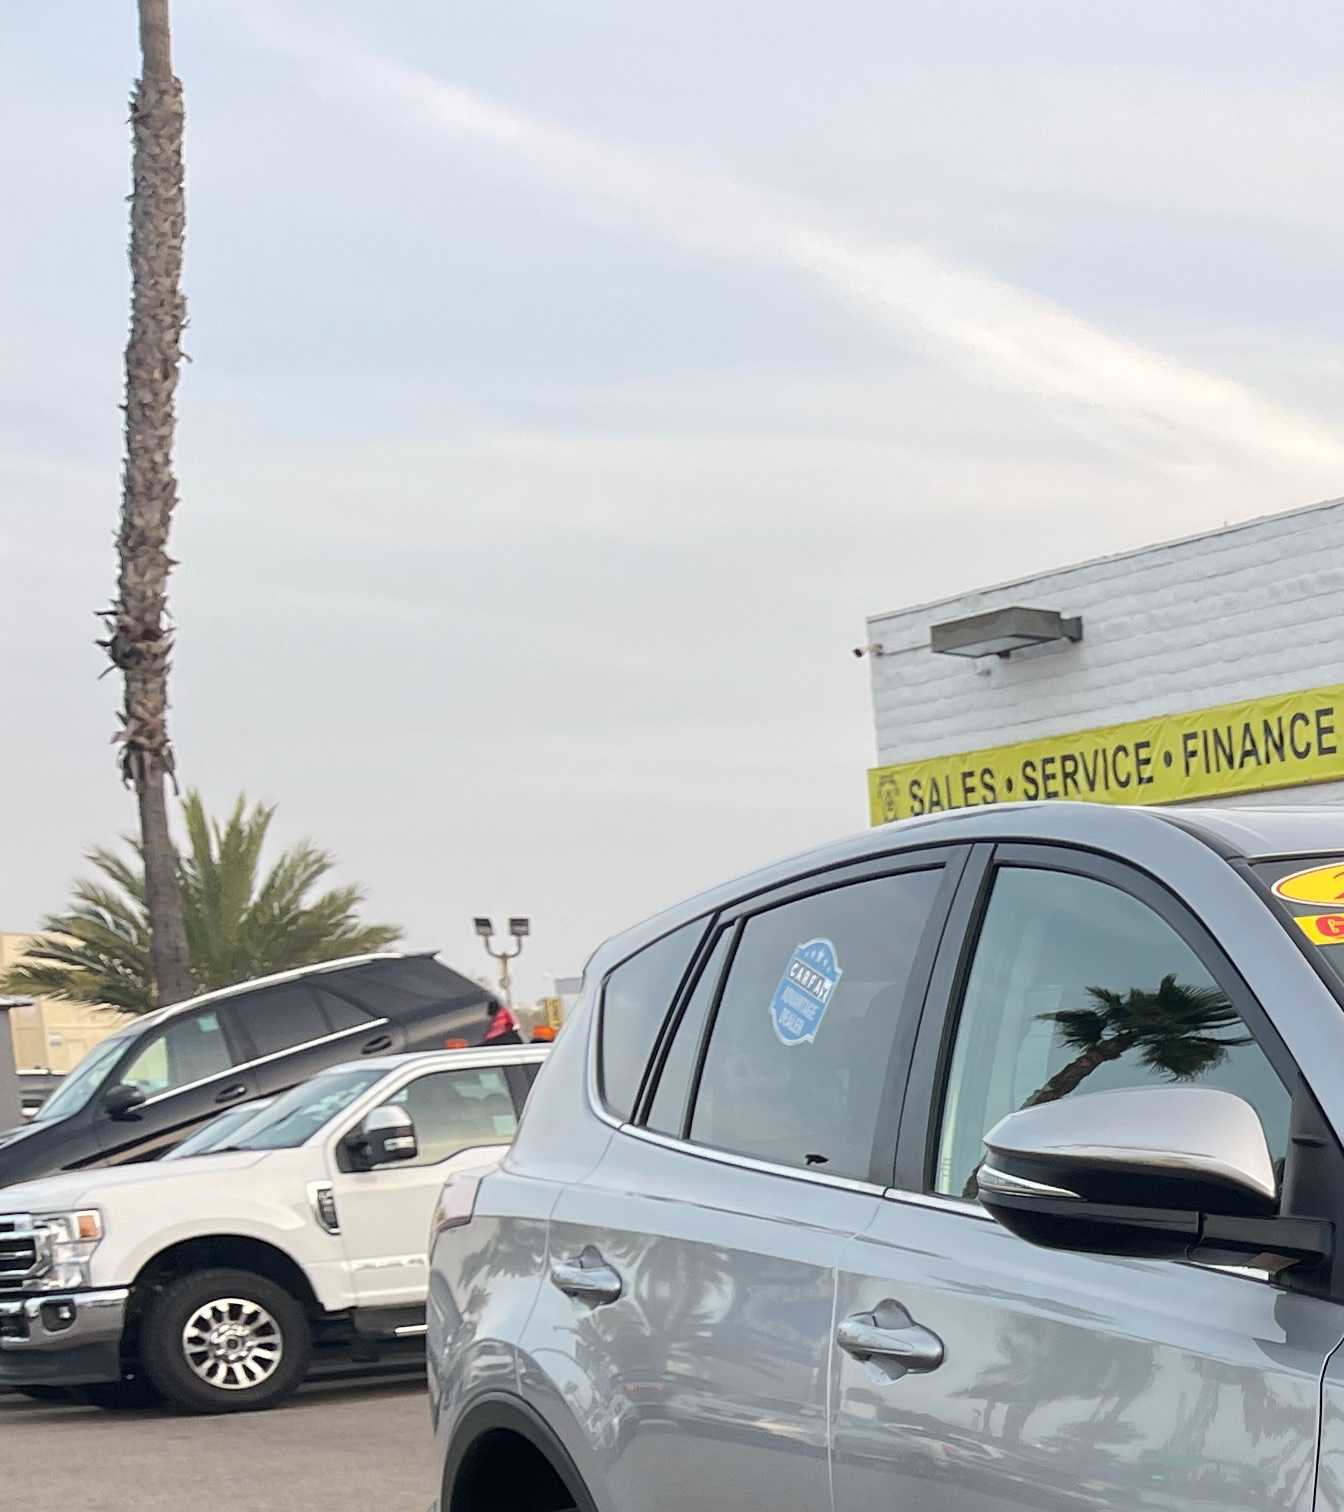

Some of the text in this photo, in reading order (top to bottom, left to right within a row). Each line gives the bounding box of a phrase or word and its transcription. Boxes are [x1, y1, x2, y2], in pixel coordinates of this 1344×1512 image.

[908, 708, 1337, 816] SALES SERVICE FINANCE
